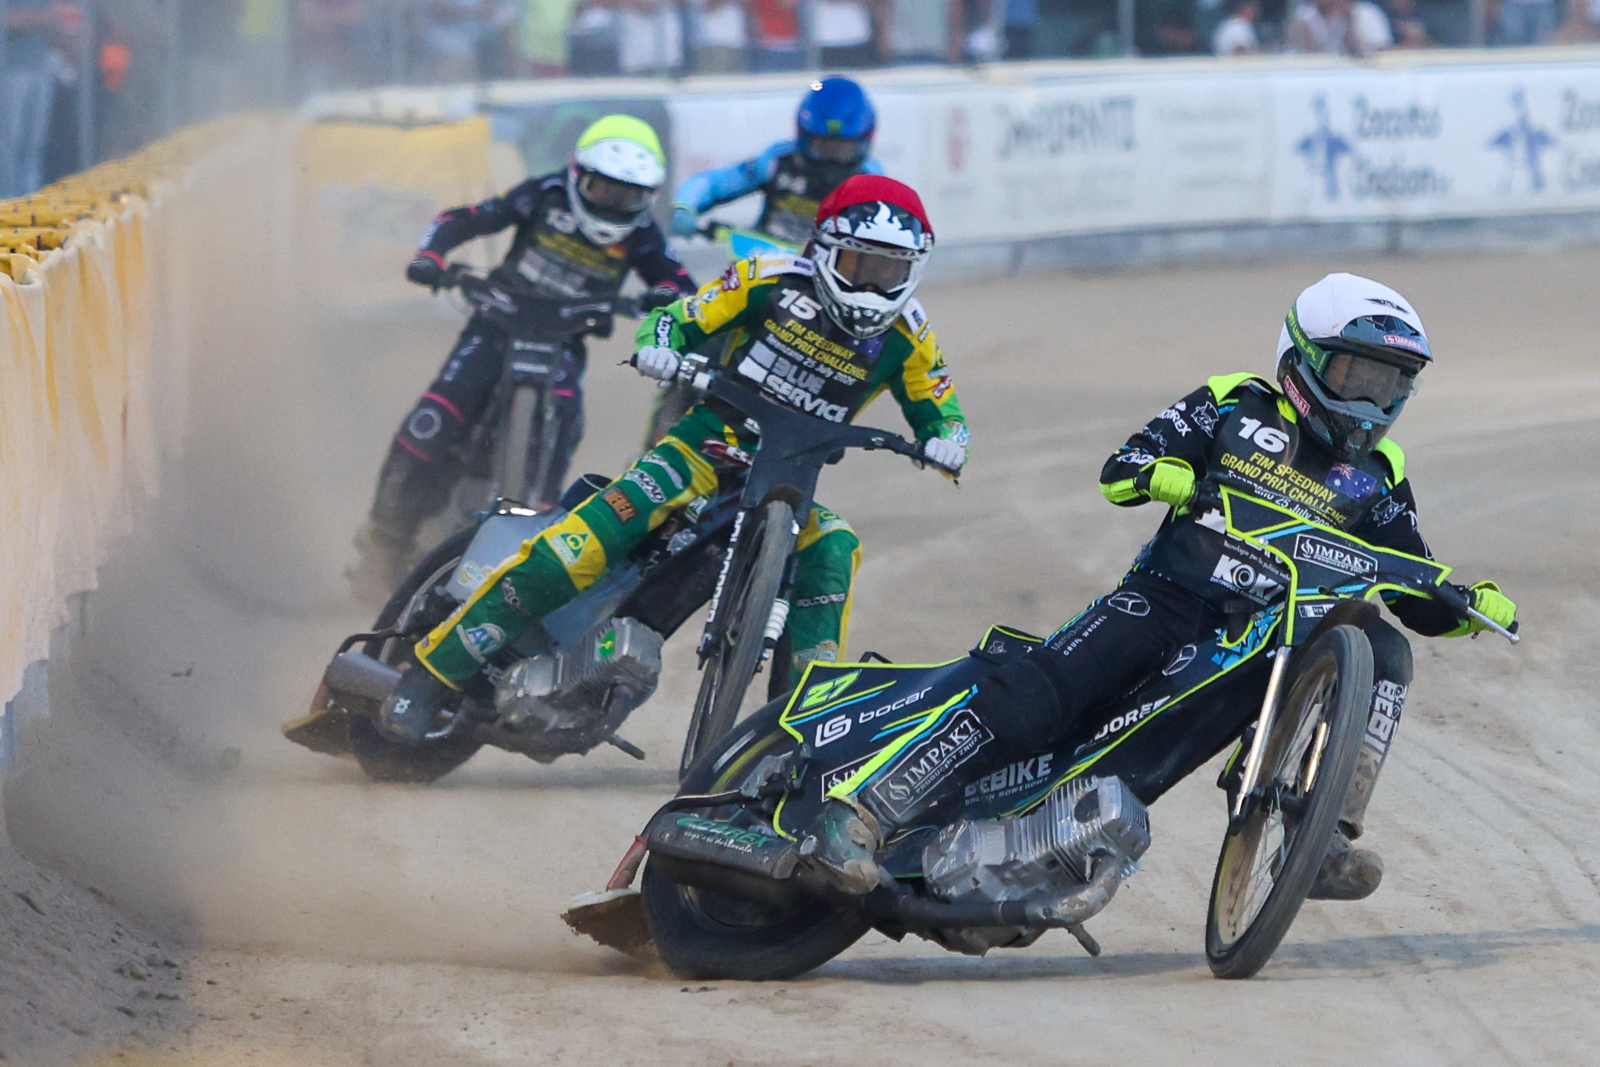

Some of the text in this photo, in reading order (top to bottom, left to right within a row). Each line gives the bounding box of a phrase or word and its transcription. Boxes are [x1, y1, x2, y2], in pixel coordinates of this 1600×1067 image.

[778, 288, 823, 320] 15
[764, 319, 868, 380] GRAND PRIX CHALLENGE
[785, 319, 856, 360] FIM SPEEDWAY
[770, 356, 826, 395] BLUE
[766, 374, 849, 423] SERVICE
[1237, 416, 1290, 453] 16
[1220, 452, 1261, 479] GRAND
[1259, 472, 1292, 494] PRIX
[1249, 451, 1337, 504] FIM SPEEDWAY
[1274, 495, 1291, 508] 25
[1289, 503, 1312, 520] July
[1315, 544, 1374, 571] IMPAKT
[802, 671, 859, 709] 27
[858, 686, 933, 724] bocar
[903, 718, 978, 787] IMPAKT
[964, 753, 1054, 797] BEBIKE
[964, 776, 1050, 807] SALN ROWEROWY
